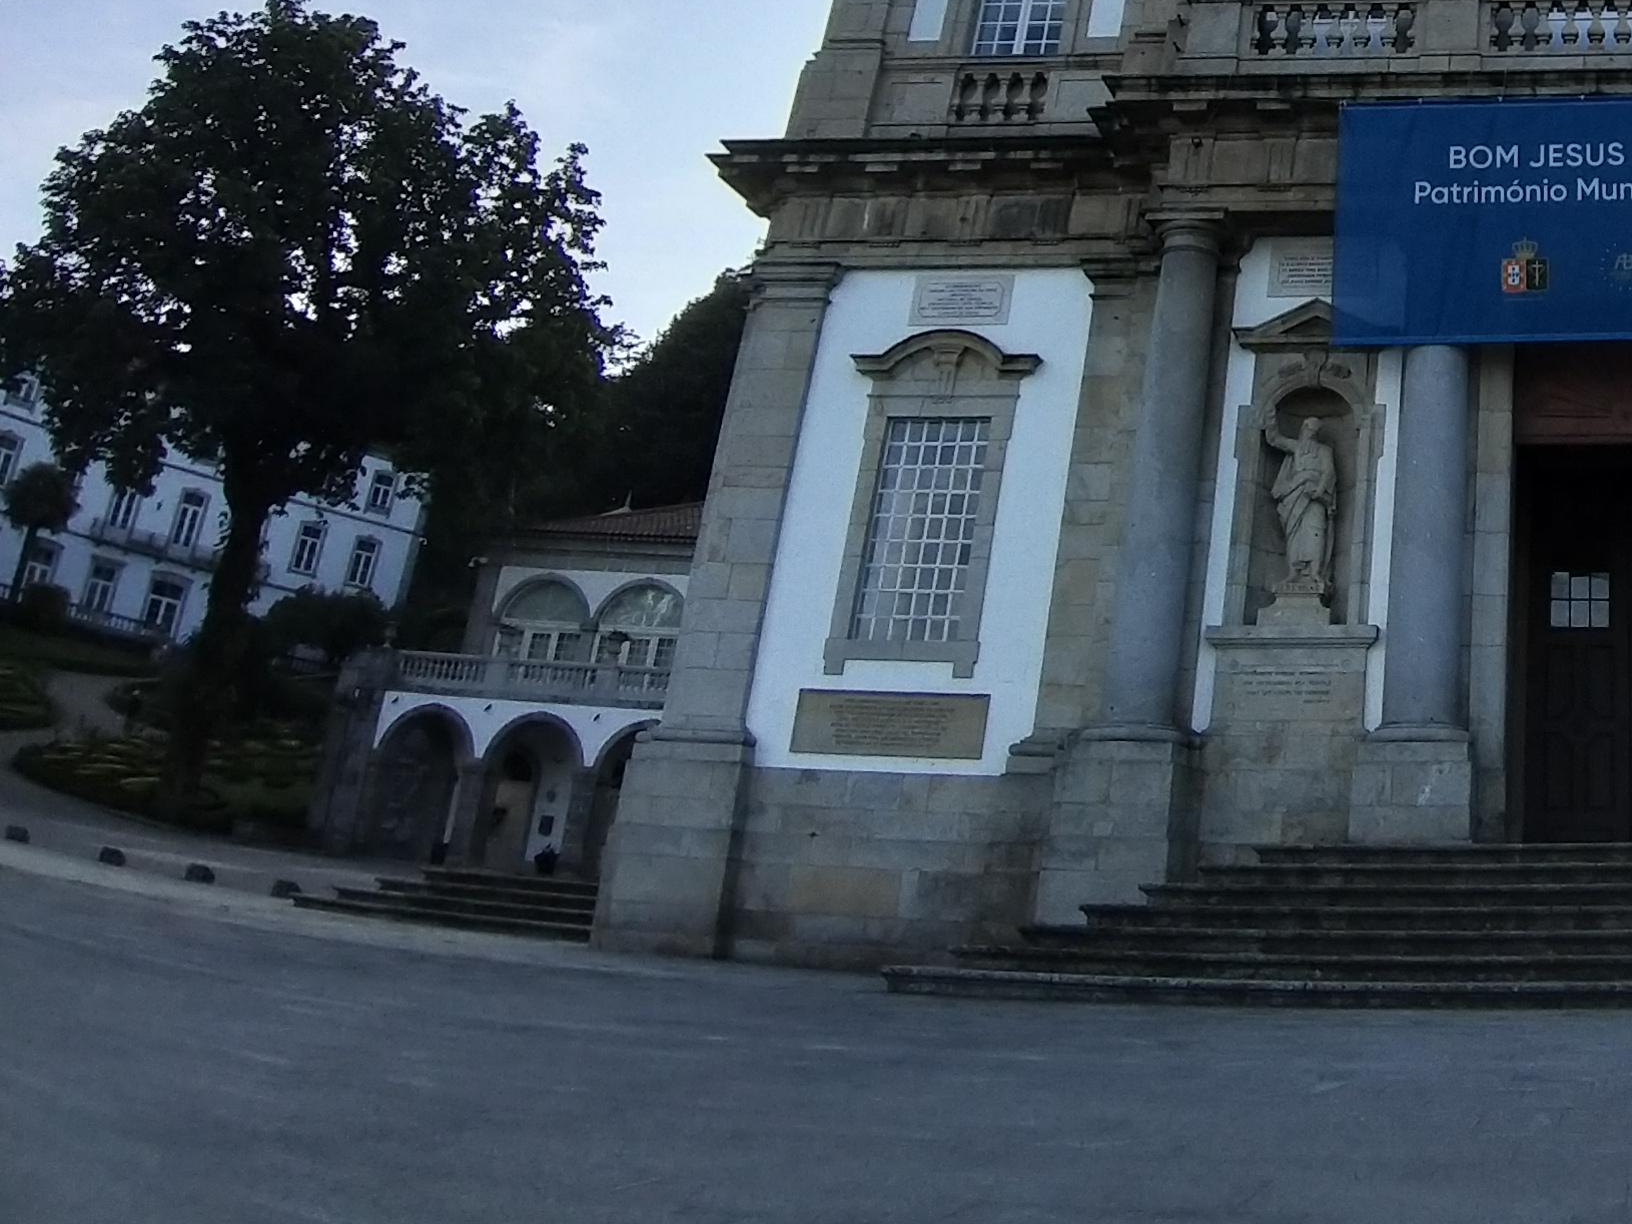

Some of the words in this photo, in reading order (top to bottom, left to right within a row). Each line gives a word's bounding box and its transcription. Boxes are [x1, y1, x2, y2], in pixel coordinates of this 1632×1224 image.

[1449, 145, 1519, 169] BOM
[1529, 142, 1625, 167] JESUS
[1414, 178, 1568, 204] Património
